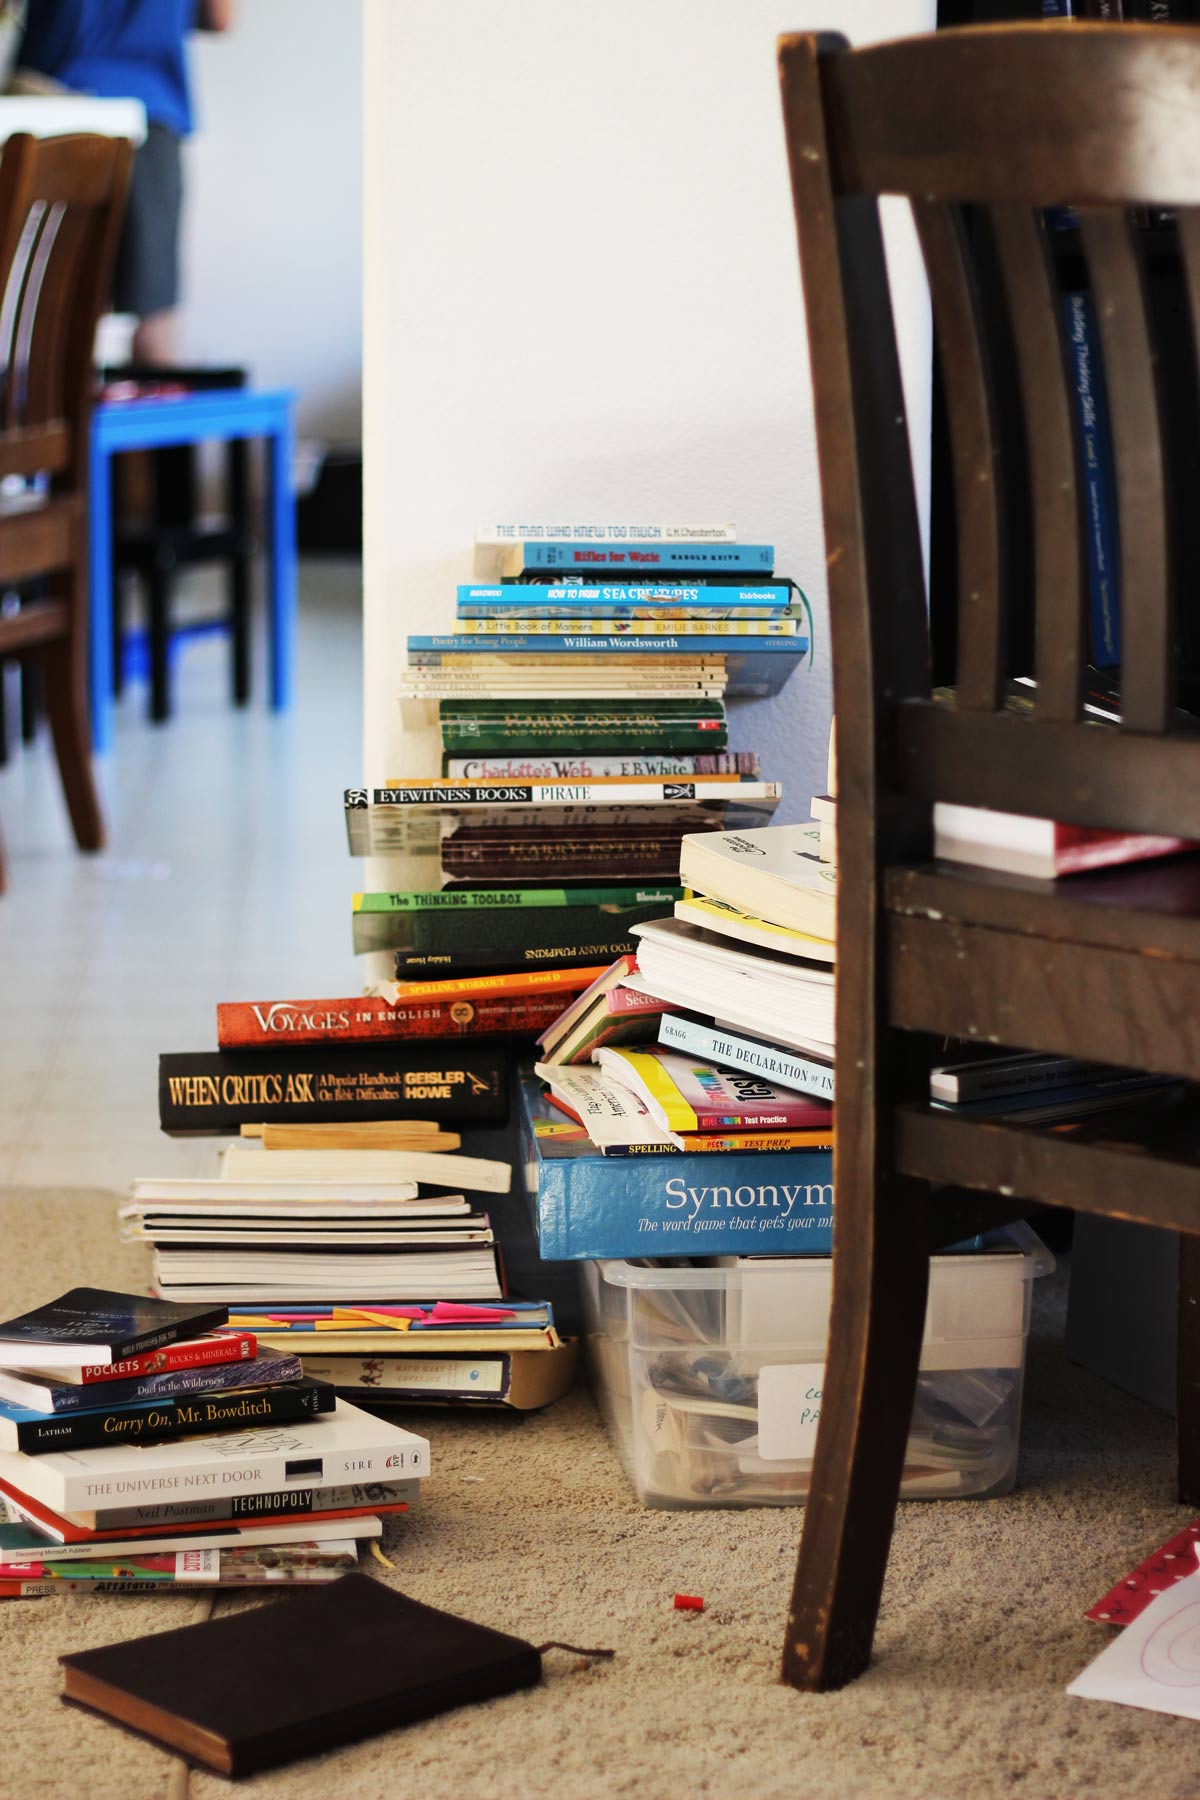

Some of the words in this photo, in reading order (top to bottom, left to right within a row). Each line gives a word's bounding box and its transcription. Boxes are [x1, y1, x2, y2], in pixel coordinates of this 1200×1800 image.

[1077, 344, 1092, 394] Thinking
[1082, 395, 1096, 428] Skills
[496, 526, 515, 538] THE
[574, 551, 606, 562] Rifles
[609, 551, 625, 562] for
[548, 590, 566, 598] HOW
[568, 590, 578, 598] TO
[602, 588, 626, 600] SEA
[477, 622, 483, 630] A
[487, 622, 510, 630] Little
[514, 622, 537, 630] Book
[540, 622, 552, 630] of
[555, 622, 593, 630] Manners
[656, 624, 689, 632] EMILIE
[692, 624, 730, 632] BARNES
[432, 637, 458, 646] Poetry
[461, 637, 474, 645] for
[474, 637, 499, 648] Young
[501, 637, 528, 648] People
[564, 638, 608, 648] William
[609, 638, 679, 648] Wordsworth
[504, 714, 576, 728] HARRY
[584, 714, 660, 728] POTTER
[464, 760, 552, 778] Charlotte's
[554, 760, 593, 778] Web
[380, 788, 471, 802] EYEWITNESS
[476, 788, 528, 800] BOOKS
[540, 786, 591, 800] PIRATE
[510, 843, 580, 855] HARRY
[589, 842, 661, 852] POTTER
[390, 894, 409, 906] The
[472, 894, 522, 904] TOOLBOX
[524, 946, 576, 960] PUMPKINS
[578, 944, 608, 956] MANY
[612, 943, 633, 954] TOO
[409, 982, 454, 994] SPELLING
[458, 978, 506, 990] WORKOUT
[252, 1003, 350, 1032] VOYAGES
[356, 1012, 372, 1022] IN
[378, 1008, 442, 1021] ENGLISH
[665, 1026, 687, 1040] GRAGG
[712, 1040, 732, 1056] THE
[736, 1048, 809, 1082] DECLARATION
[319, 1074, 327, 1086] A
[359, 1072, 401, 1085] Handbook
[404, 1072, 465, 1084] GEISLER
[168, 1076, 221, 1106] WHEN
[222, 1074, 282, 1105] CRITICS
[285, 1074, 315, 1103] ASK
[319, 1088, 332, 1100] On
[406, 1086, 452, 1099] HOWE
[744, 1116, 758, 1124] Test
[760, 1116, 788, 1124] Practice
[628, 1144, 678, 1154] SPELLING
[744, 1140, 766, 1148] TEST
[766, 1139, 790, 1147] PREP
[638, 1218, 659, 1232] The
[662, 1218, 690, 1231] word
[694, 1219, 726, 1233] game
[730, 1216, 756, 1230] that
[759, 1216, 785, 1232] gets
[788, 1218, 815, 1232] your
[170, 1353, 194, 1364] ROCKS
[202, 1348, 237, 1360] MINERALS
[86, 1360, 139, 1378] POCKETS
[138, 1384, 156, 1396] Duel
[158, 1384, 166, 1392] in
[168, 1382, 180, 1391] the
[182, 1376, 225, 1388] Wilderness
[104, 1417, 144, 1434] Carry
[148, 1412, 172, 1428] On,
[176, 1406, 202, 1424] Mr.
[206, 1398, 272, 1421] Bowditch
[344, 1460, 372, 1471] SIRE
[392, 1454, 400, 1467] IVP
[86, 1483, 113, 1496] THE
[116, 1476, 180, 1493] UNIVERSE
[184, 1473, 218, 1487] NEXT
[222, 1469, 262, 1484] DOOR
[233, 1492, 312, 1512] TECHNOPOLY
[136, 1507, 160, 1520] Neil
[164, 1504, 216, 1518] Postman
[16, 1550, 44, 1558] Discovering
[44, 1548, 68, 1556] Microsoft
[69, 1546, 92, 1554] Publisher
[26, 1585, 56, 1594] PRESS
